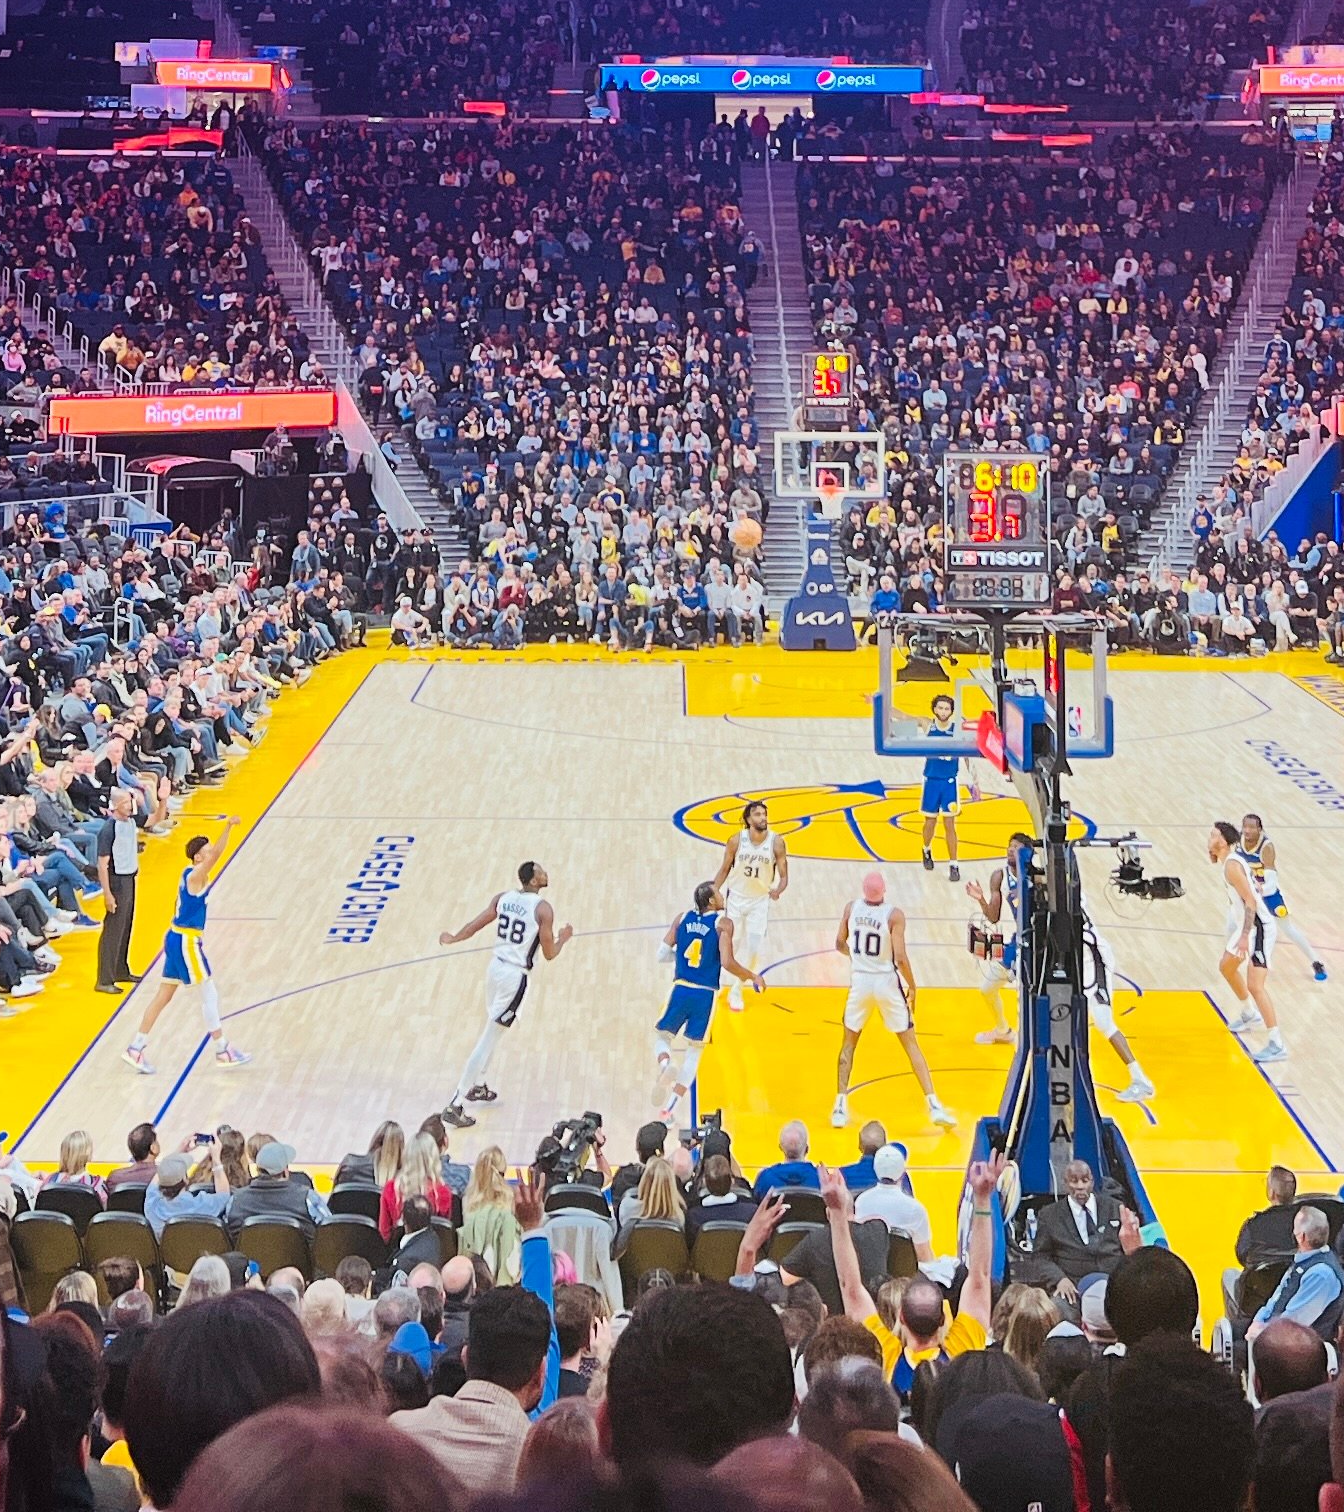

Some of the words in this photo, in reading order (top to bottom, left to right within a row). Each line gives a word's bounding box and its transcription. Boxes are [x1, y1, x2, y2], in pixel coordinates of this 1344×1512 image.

[176, 64, 253, 84] RingCentral
[662, 73, 701, 87] pepsi
[752, 73, 791, 87] pepsi
[837, 74, 876, 88] pepsi
[145, 401, 243, 427] RingCentral
[975, 462, 1037, 493] 6:10
[980, 550, 1045, 567] TISSOT
[356, 835, 415, 880] CHASE
[744, 865, 760, 878] 31
[323, 894, 390, 945] CENTER
[497, 914, 526, 945] 28
[684, 937, 703, 968] 4
[854, 930, 881, 956] 10
